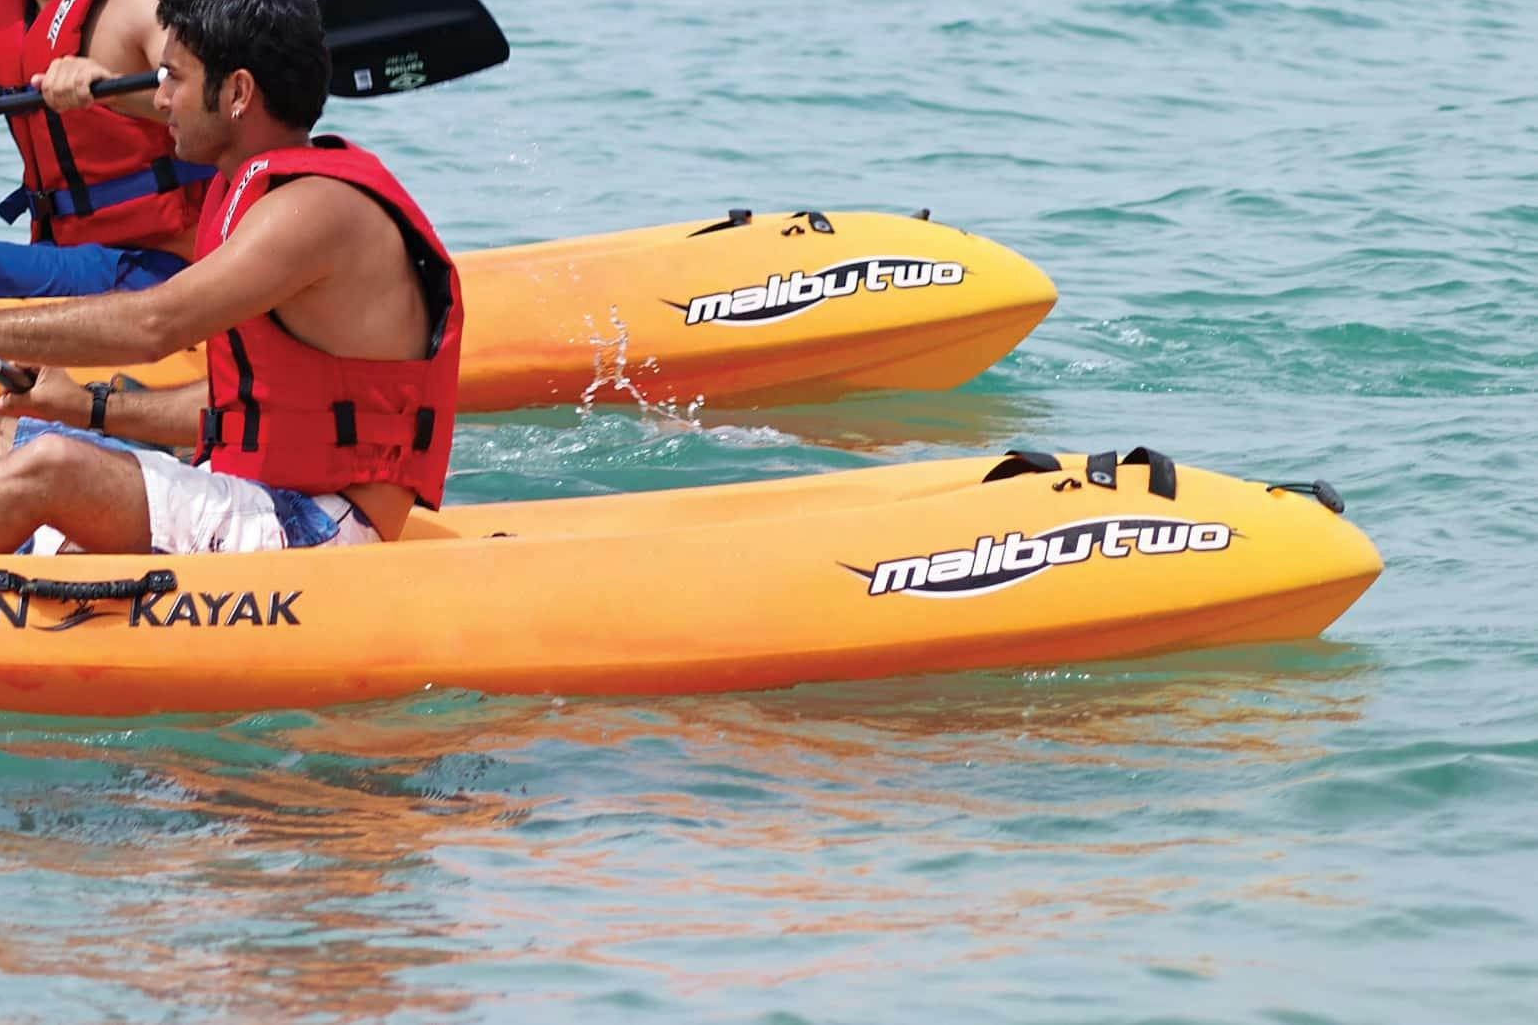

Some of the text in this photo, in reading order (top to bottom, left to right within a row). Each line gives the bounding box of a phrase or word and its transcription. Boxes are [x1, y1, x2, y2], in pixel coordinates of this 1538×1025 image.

[685, 259, 965, 326] malibu two
[868, 518, 1232, 596] malibu two
[128, 590, 303, 628] KAYAK
